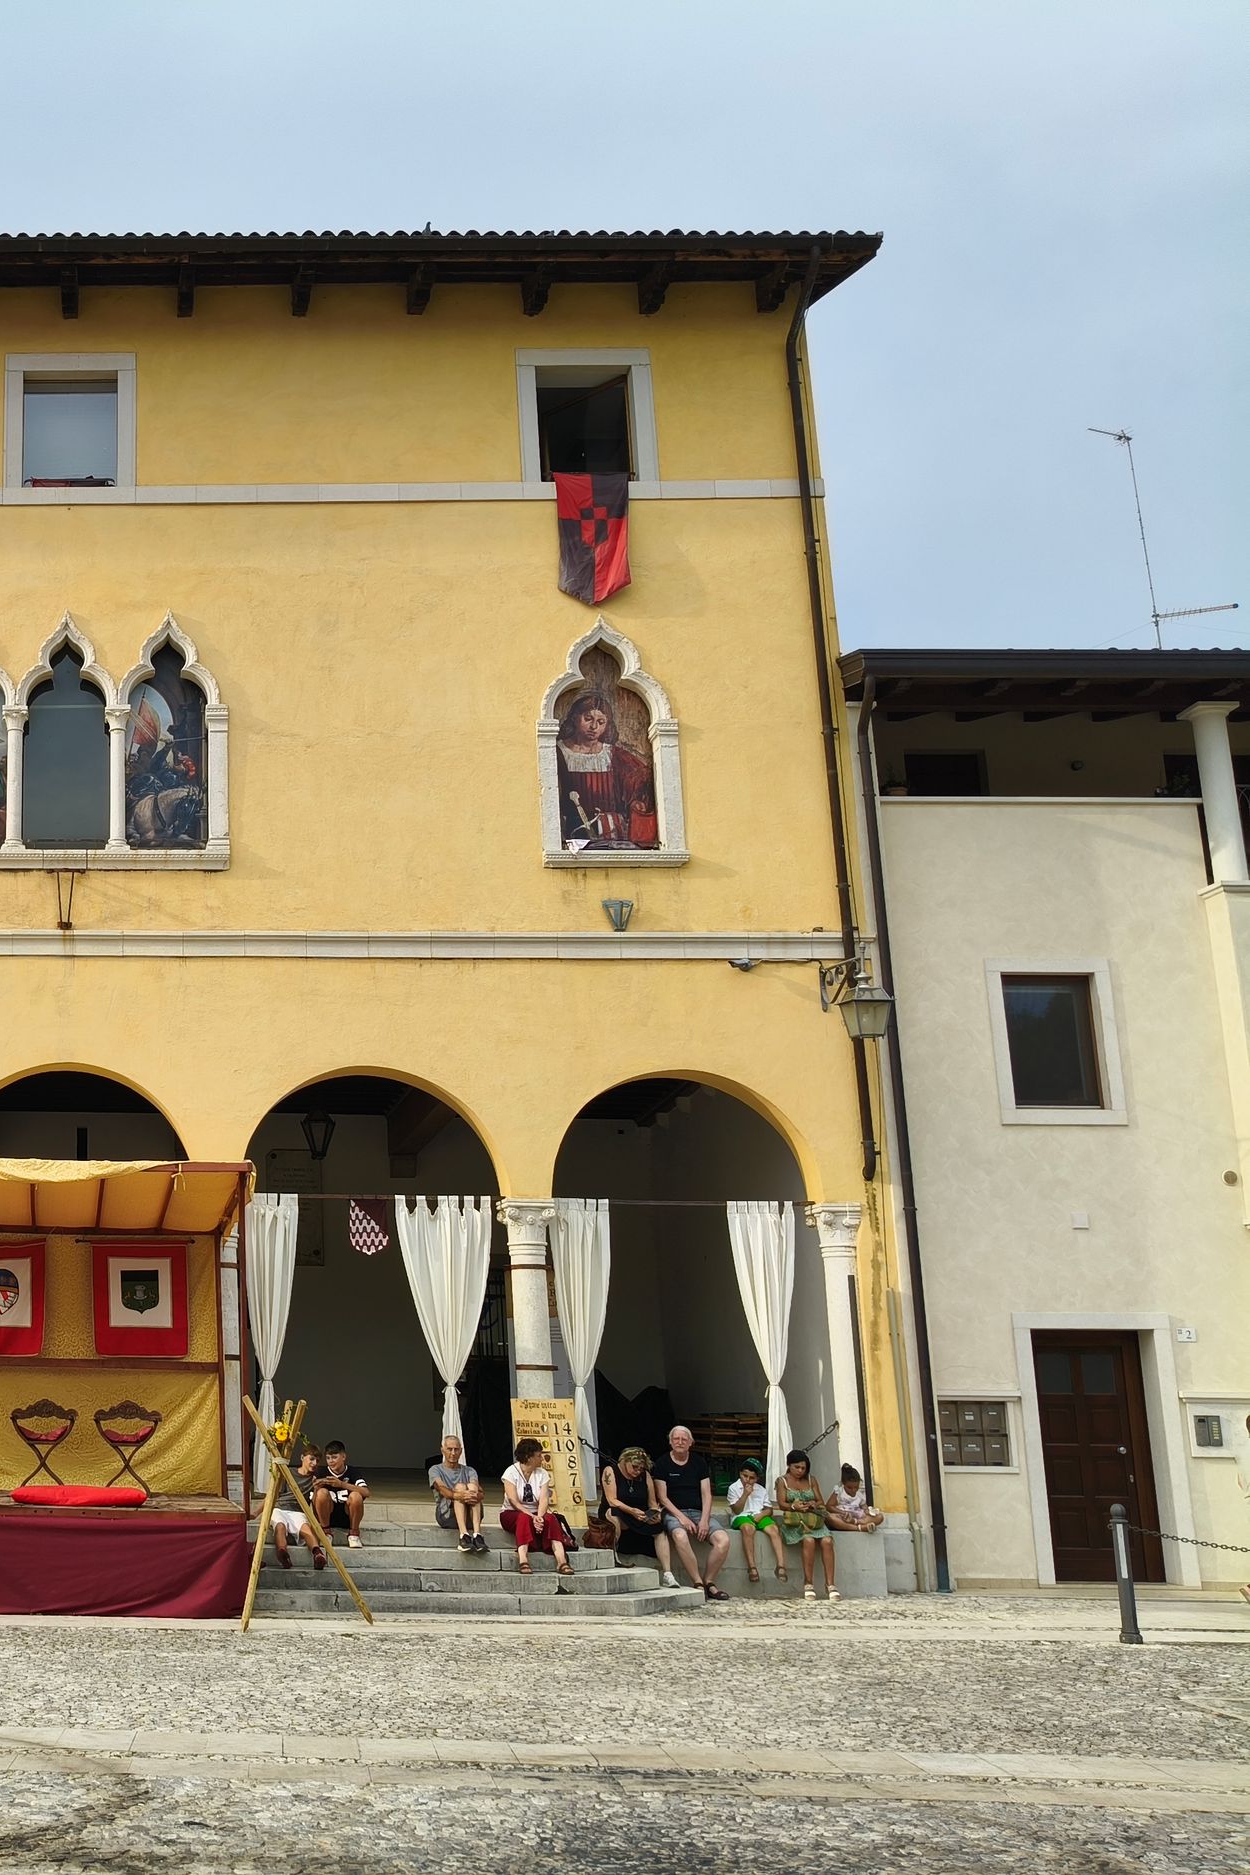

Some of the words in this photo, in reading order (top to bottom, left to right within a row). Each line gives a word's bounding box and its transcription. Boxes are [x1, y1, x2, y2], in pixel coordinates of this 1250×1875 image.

[553, 1422, 572, 1436] 14
[555, 1439, 575, 1452] 10
[567, 1455, 577, 1469] 8
[569, 1473, 578, 1487] 7
[572, 1490, 582, 1505] 6
